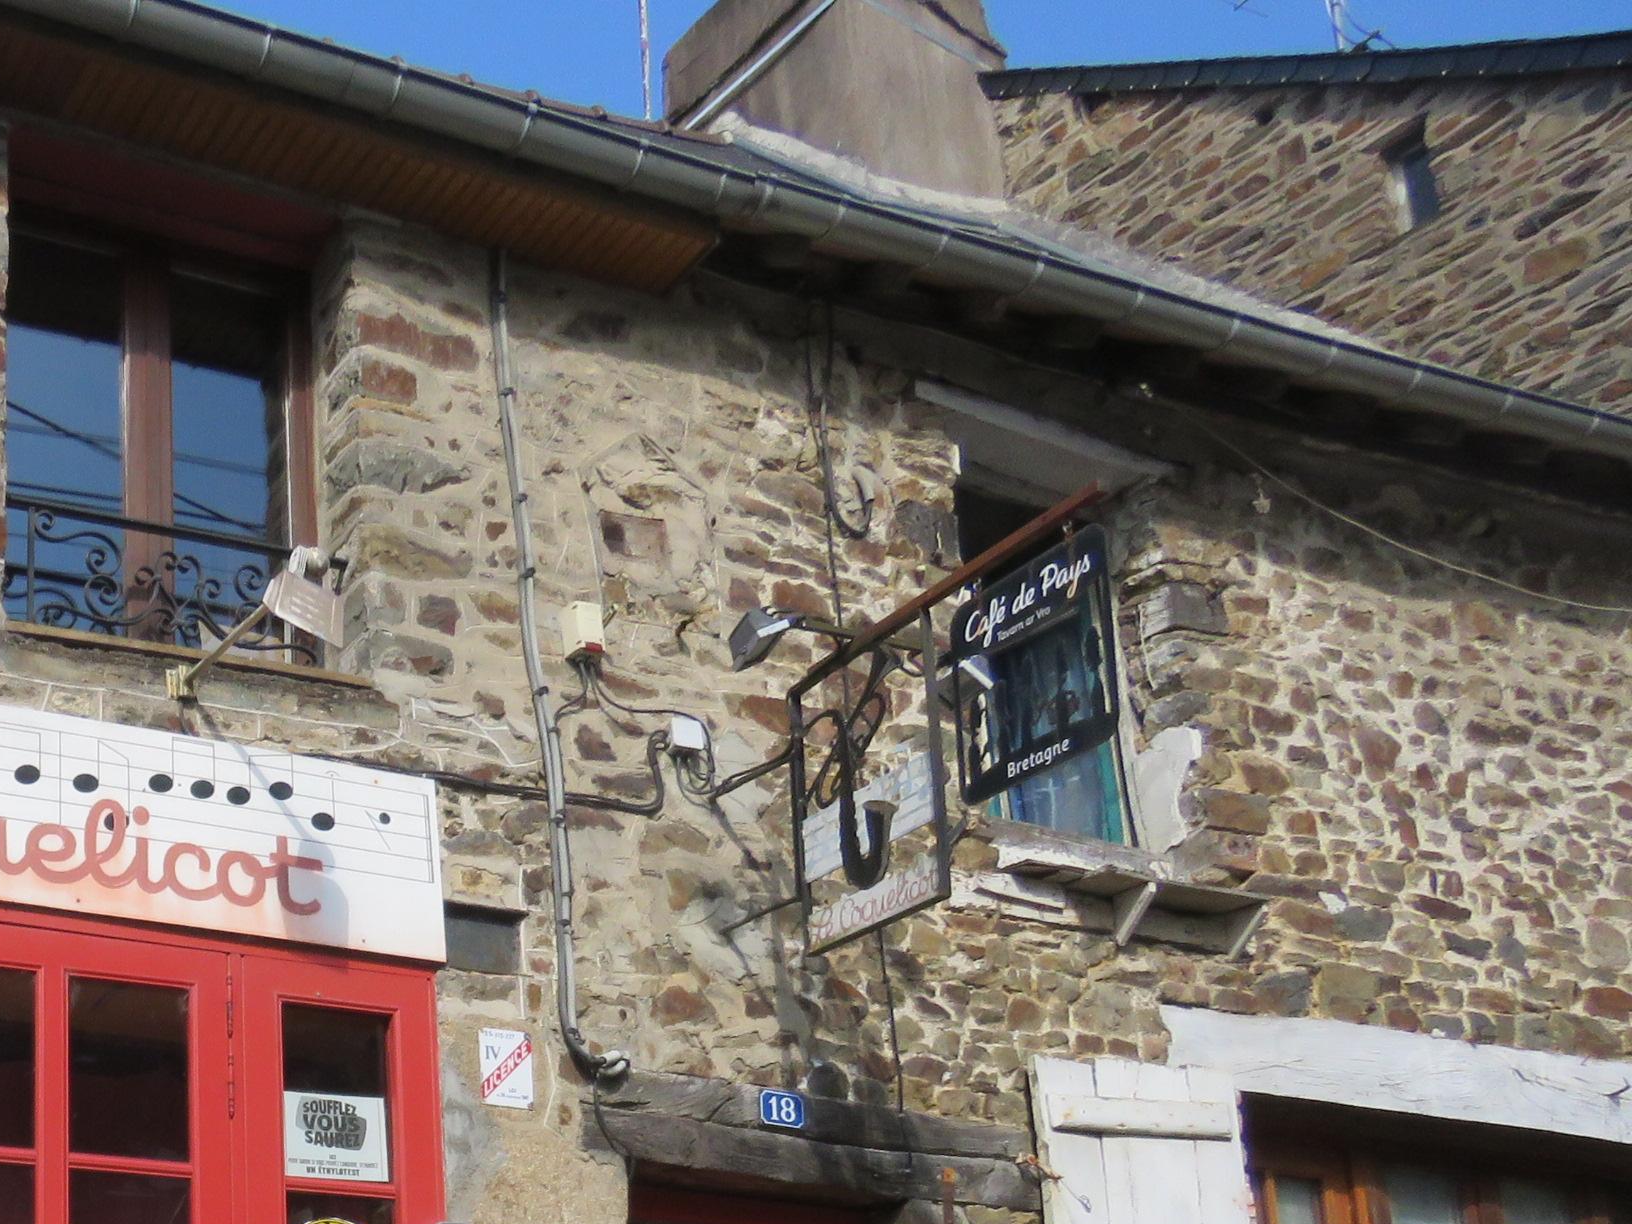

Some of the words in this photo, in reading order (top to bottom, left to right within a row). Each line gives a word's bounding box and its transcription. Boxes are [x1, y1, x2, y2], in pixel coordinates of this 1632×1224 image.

[964, 595, 1007, 648] Café
[1012, 582, 1035, 615] de
[1039, 553, 1091, 599] Pays
[1006, 737, 1070, 778] Bretagne
[840, 869, 939, 931] Coquelicot
[485, 1045, 501, 1060] IV
[484, 1040, 529, 1096] LICENCE
[303, 1099, 358, 1116] SOUFFLEZ
[768, 1096, 796, 1122] 18
[303, 1114, 361, 1132] VOUS
[304, 1130, 361, 1148] SAUREZ
[306, 1166, 316, 1174] UN
